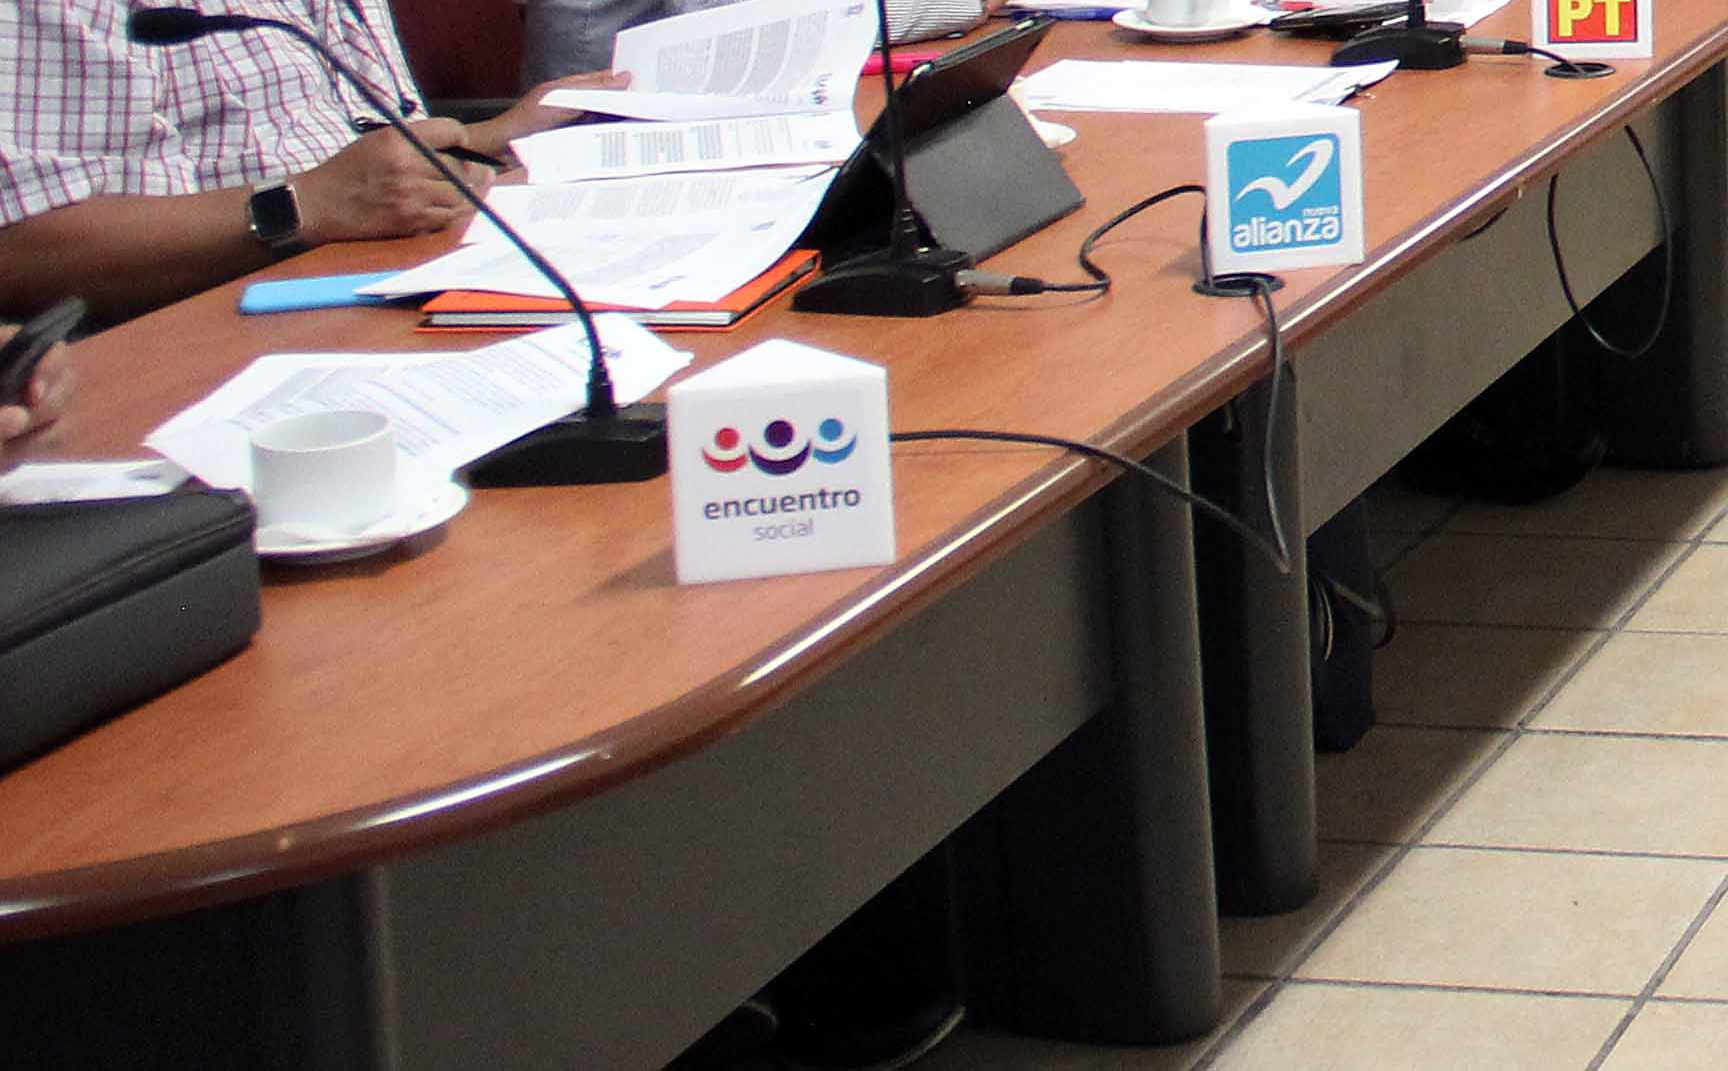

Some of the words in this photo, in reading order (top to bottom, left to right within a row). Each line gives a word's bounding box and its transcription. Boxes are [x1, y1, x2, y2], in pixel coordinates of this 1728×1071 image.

[1233, 216, 1339, 248] alianza
[703, 487, 861, 521] encuentro
[753, 518, 815, 542] social
